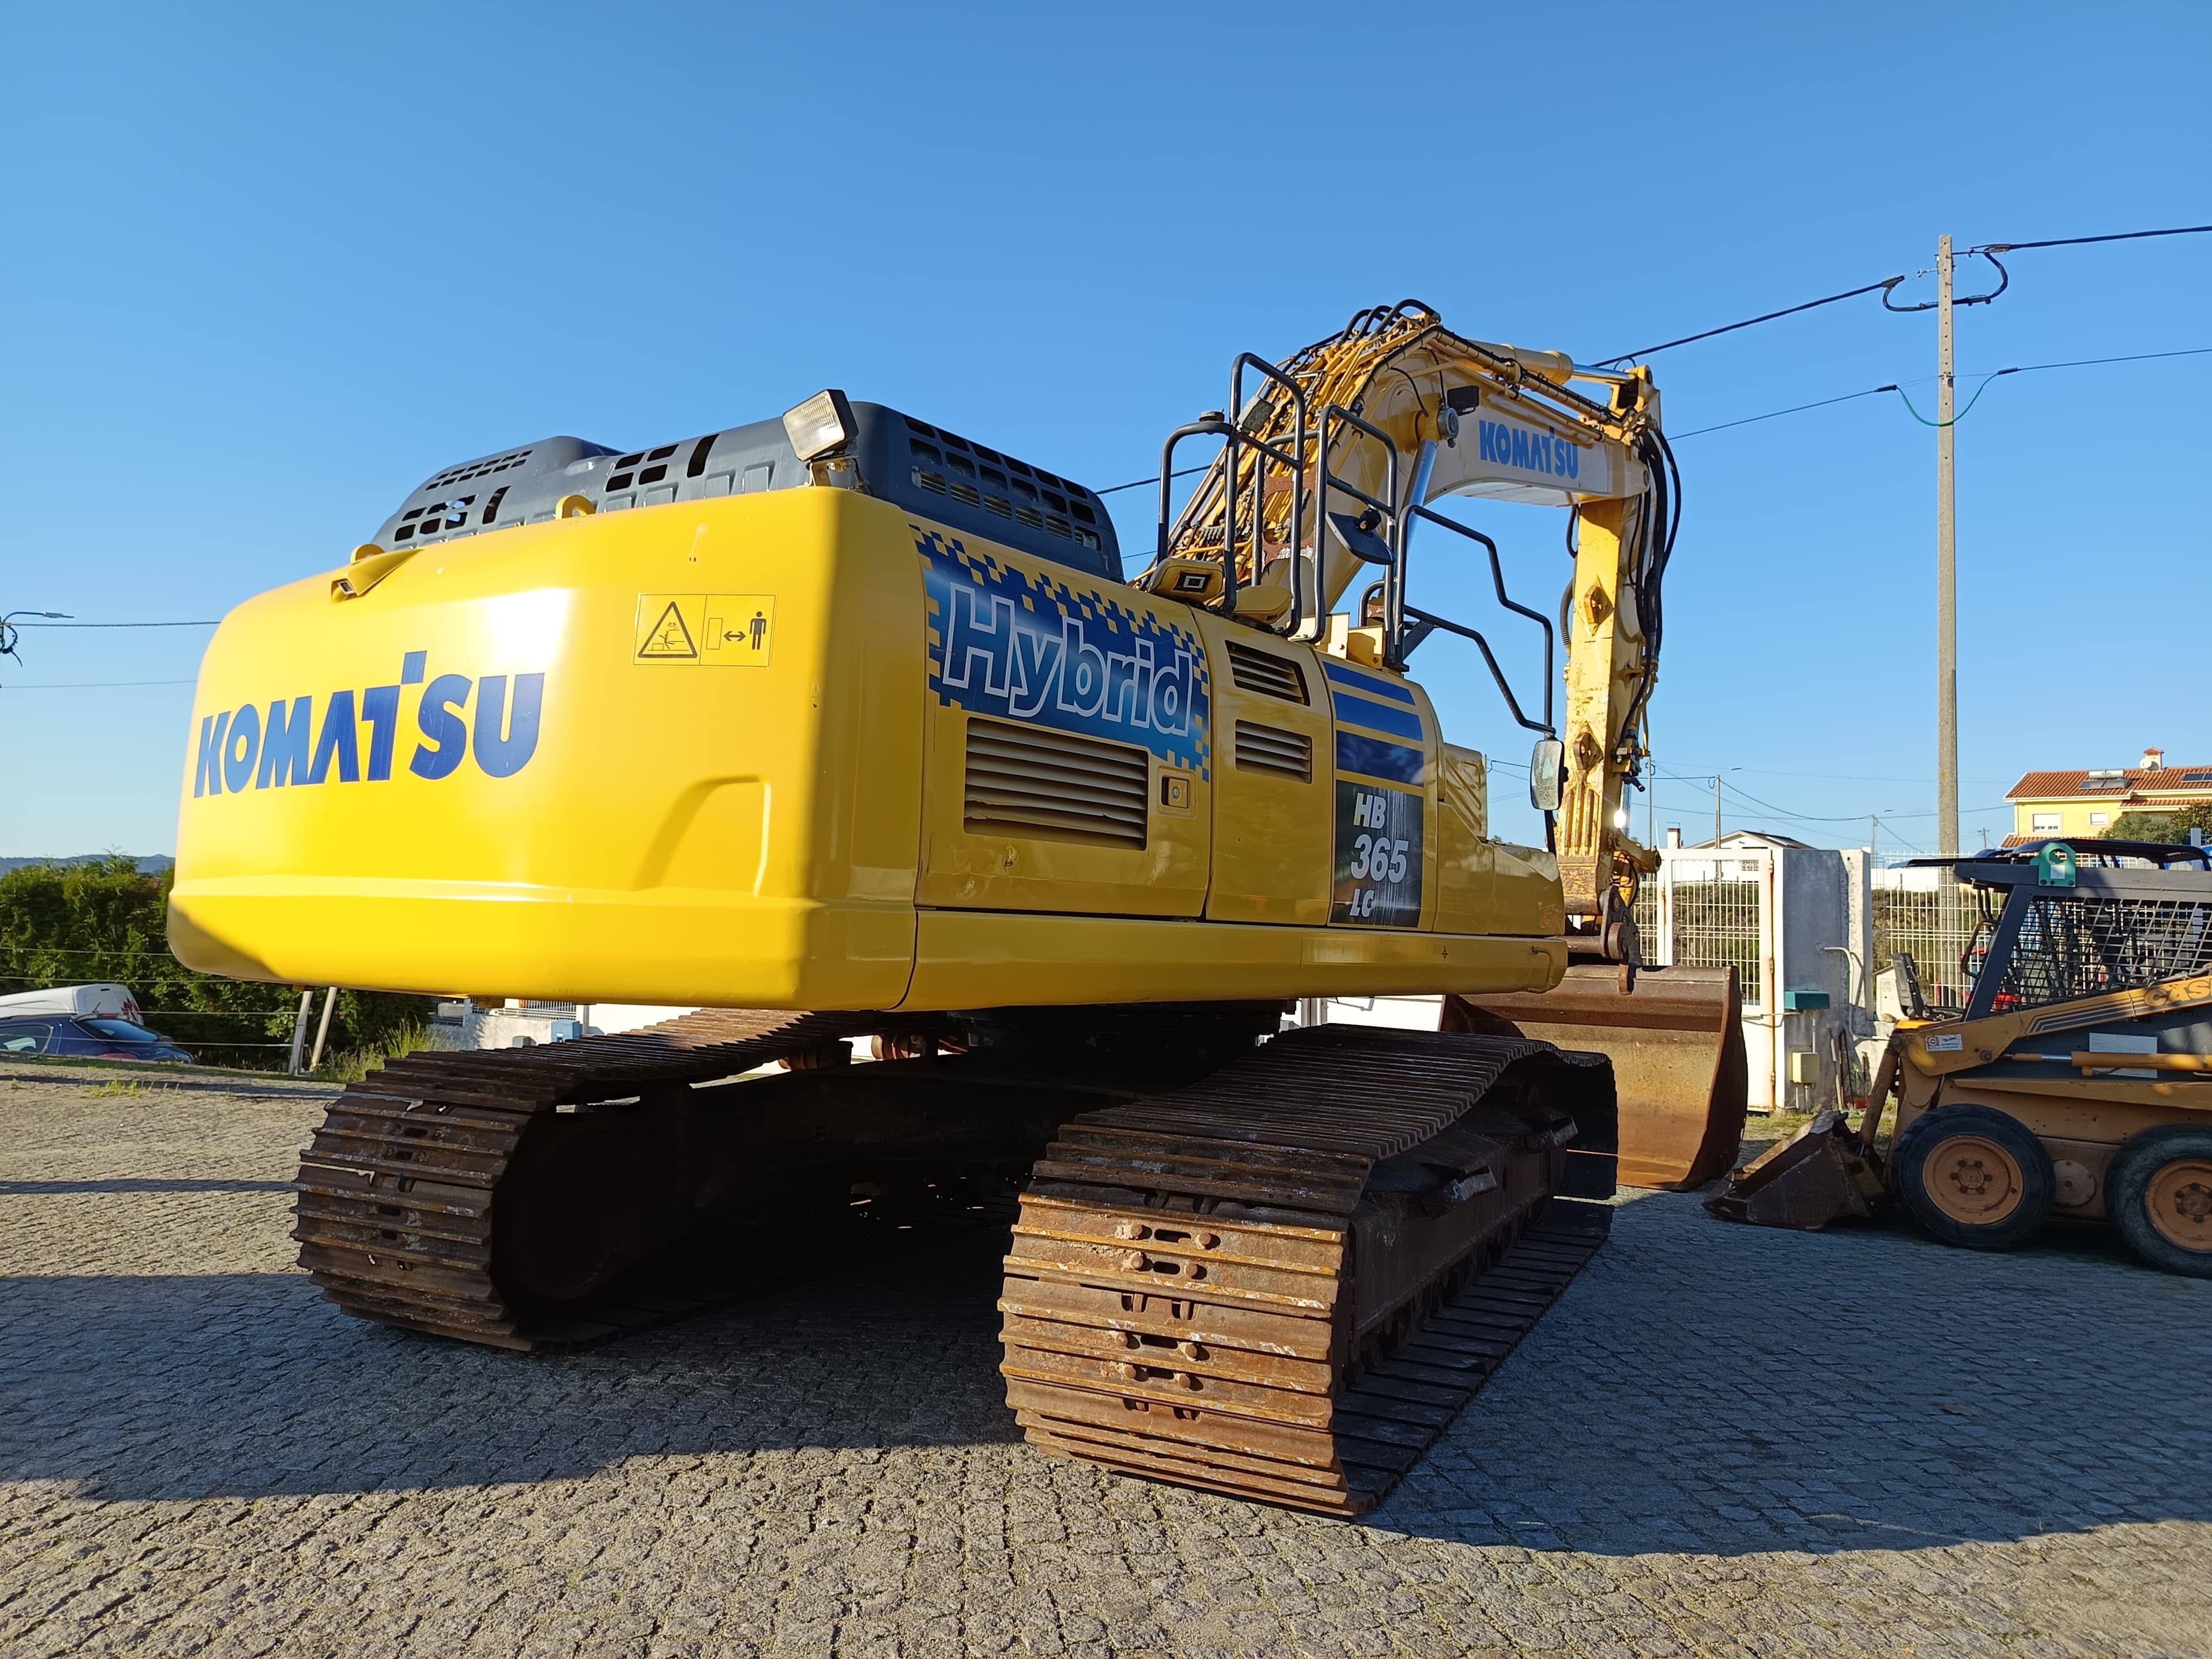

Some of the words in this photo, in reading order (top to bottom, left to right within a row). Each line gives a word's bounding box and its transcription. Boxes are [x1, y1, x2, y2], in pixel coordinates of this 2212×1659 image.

[1478, 419, 1579, 480] KOMATSU
[942, 582, 1193, 737] Hybrid
[194, 650, 545, 798] KOMATSU
[1353, 792, 1387, 829] HB
[1351, 834, 1409, 884] 365
[1349, 889, 1374, 918] LC
[2144, 978, 2212, 1007] CAS
